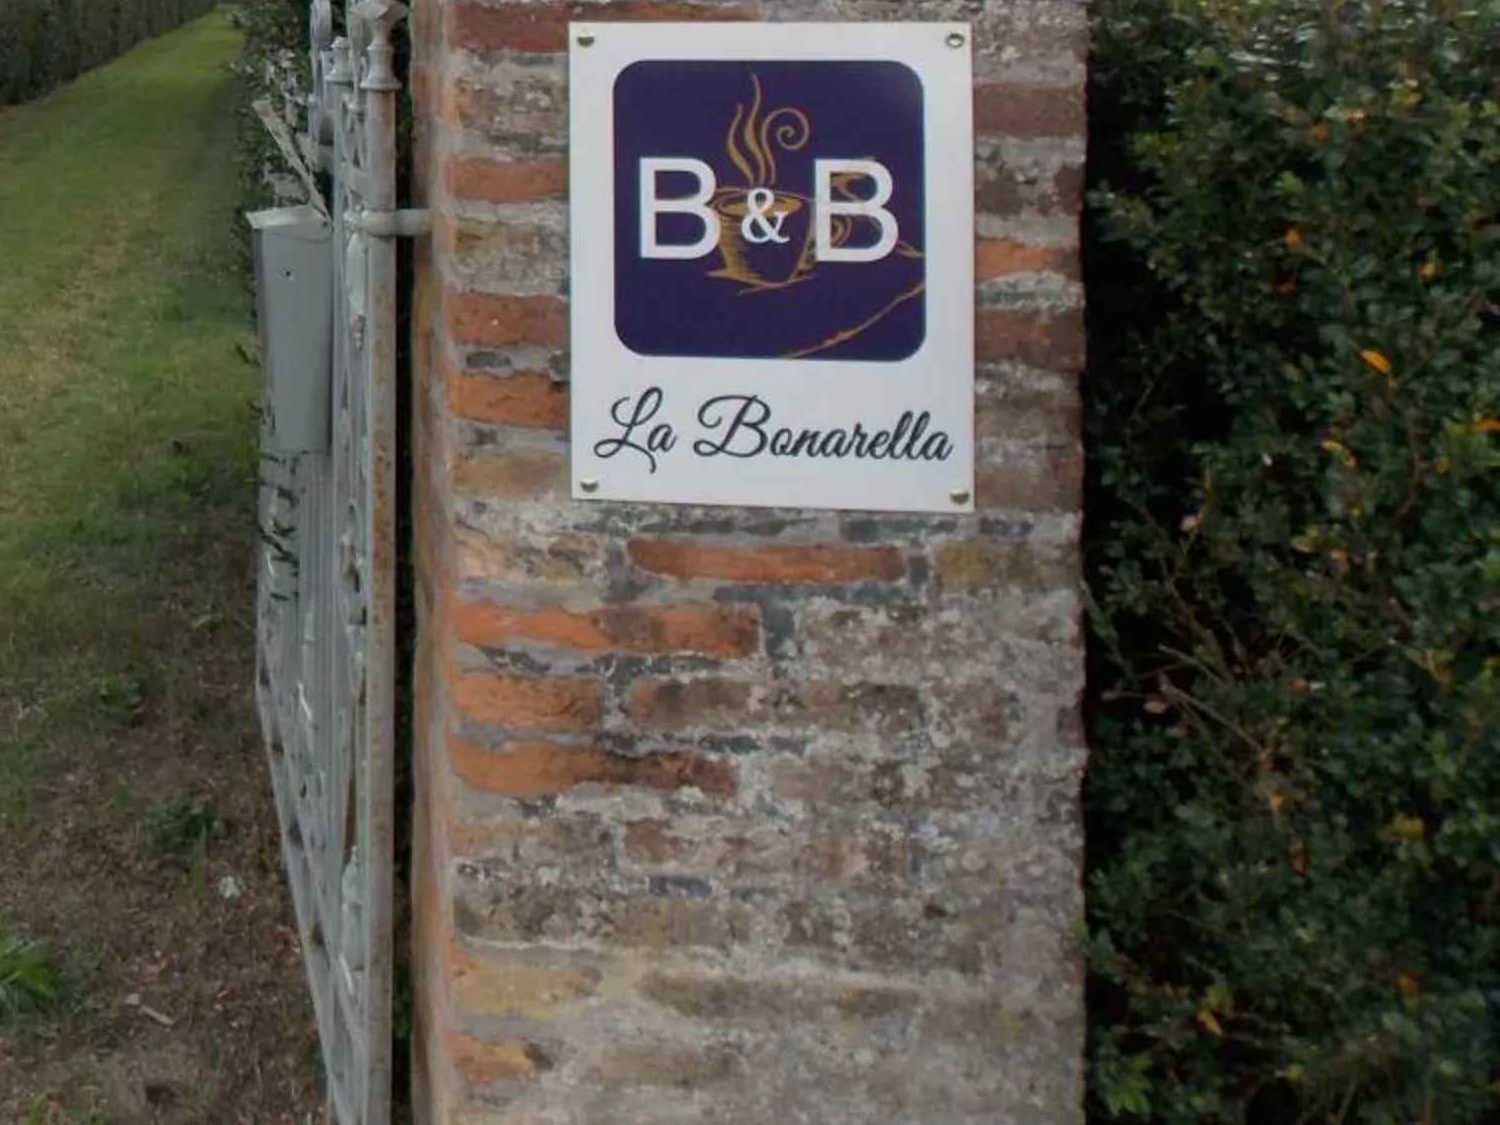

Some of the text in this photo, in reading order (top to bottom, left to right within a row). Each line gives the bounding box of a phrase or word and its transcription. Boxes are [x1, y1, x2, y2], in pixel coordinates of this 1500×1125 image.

[639, 156, 900, 263] B&B
[593, 386, 954, 475] La Bonarella
